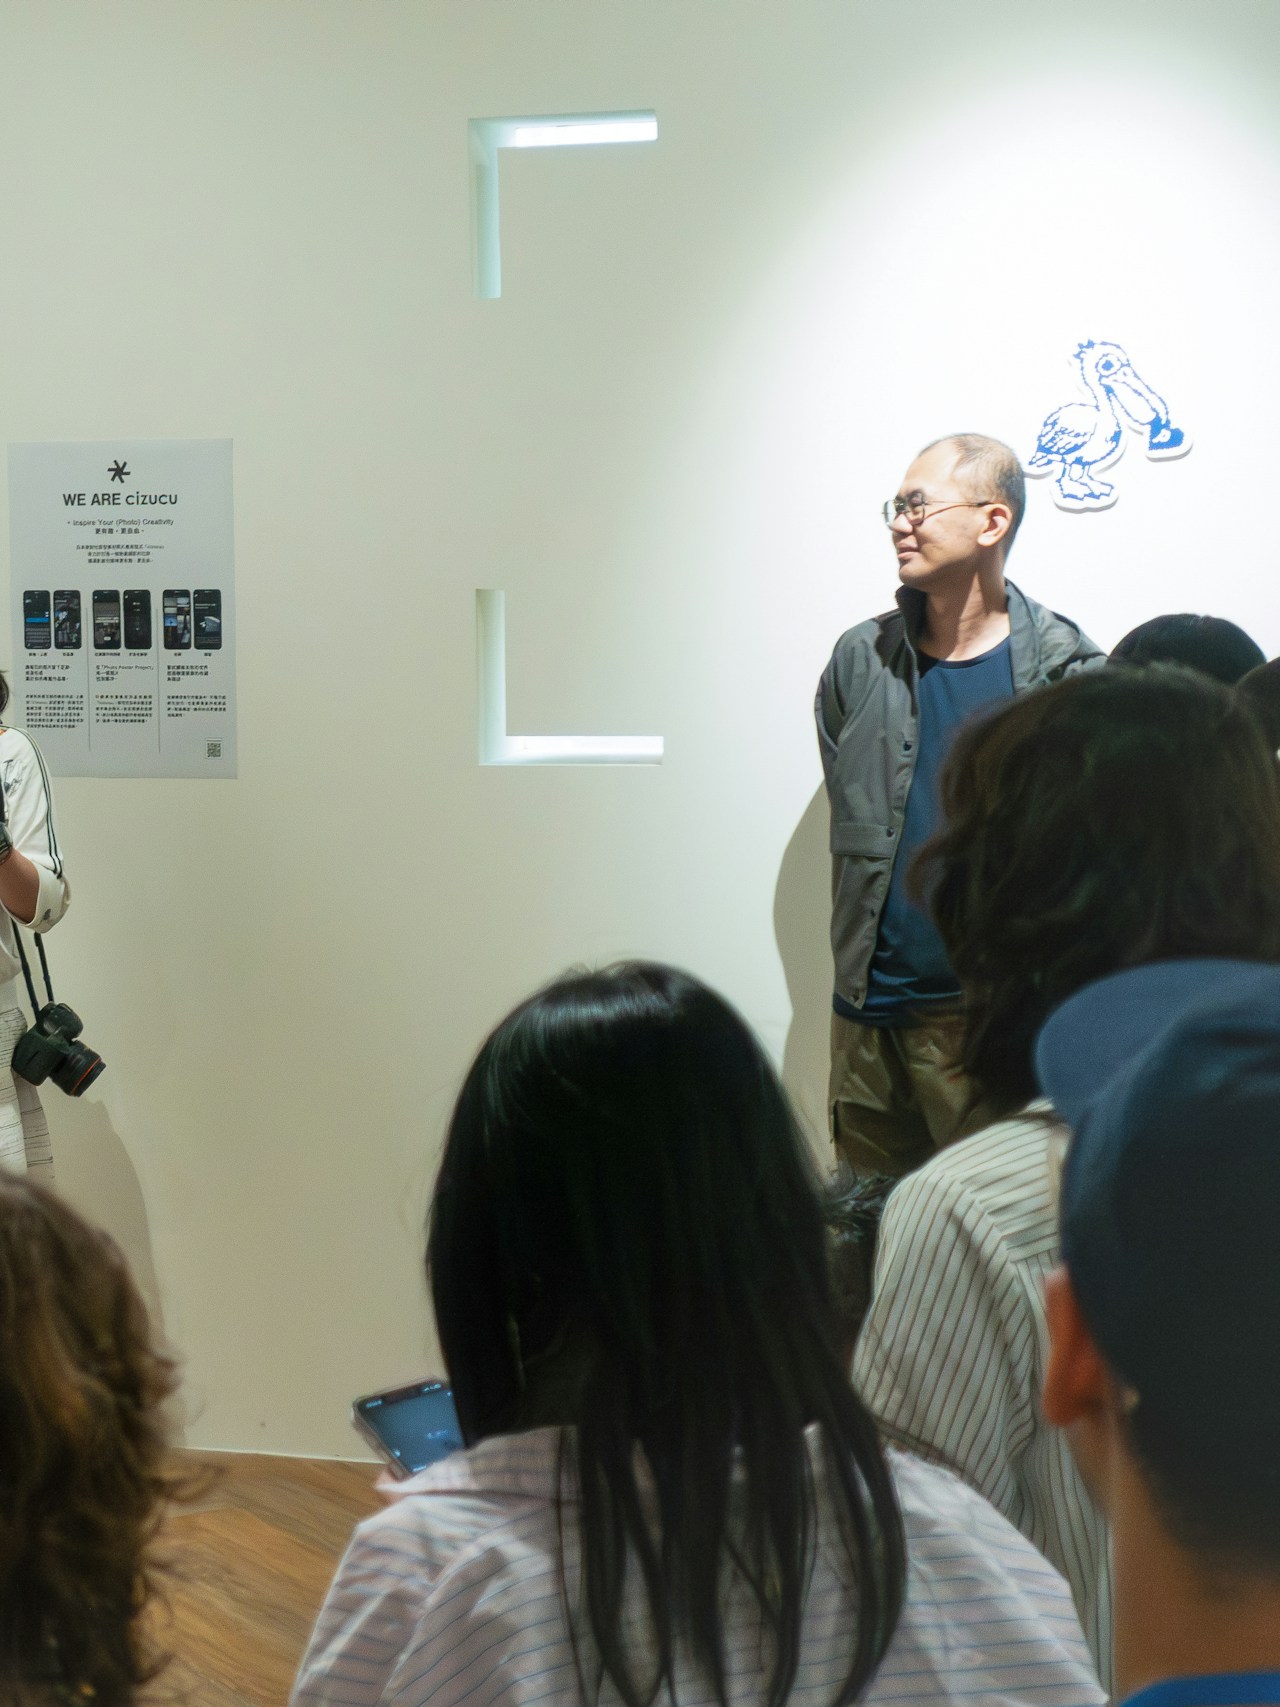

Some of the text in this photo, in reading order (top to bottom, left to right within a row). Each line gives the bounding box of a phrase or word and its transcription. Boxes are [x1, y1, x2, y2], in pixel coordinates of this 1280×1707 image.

[62, 491, 178, 506] WE ARE cizucu
[72, 518, 175, 527] Inspire Your (Photo) Creativity
